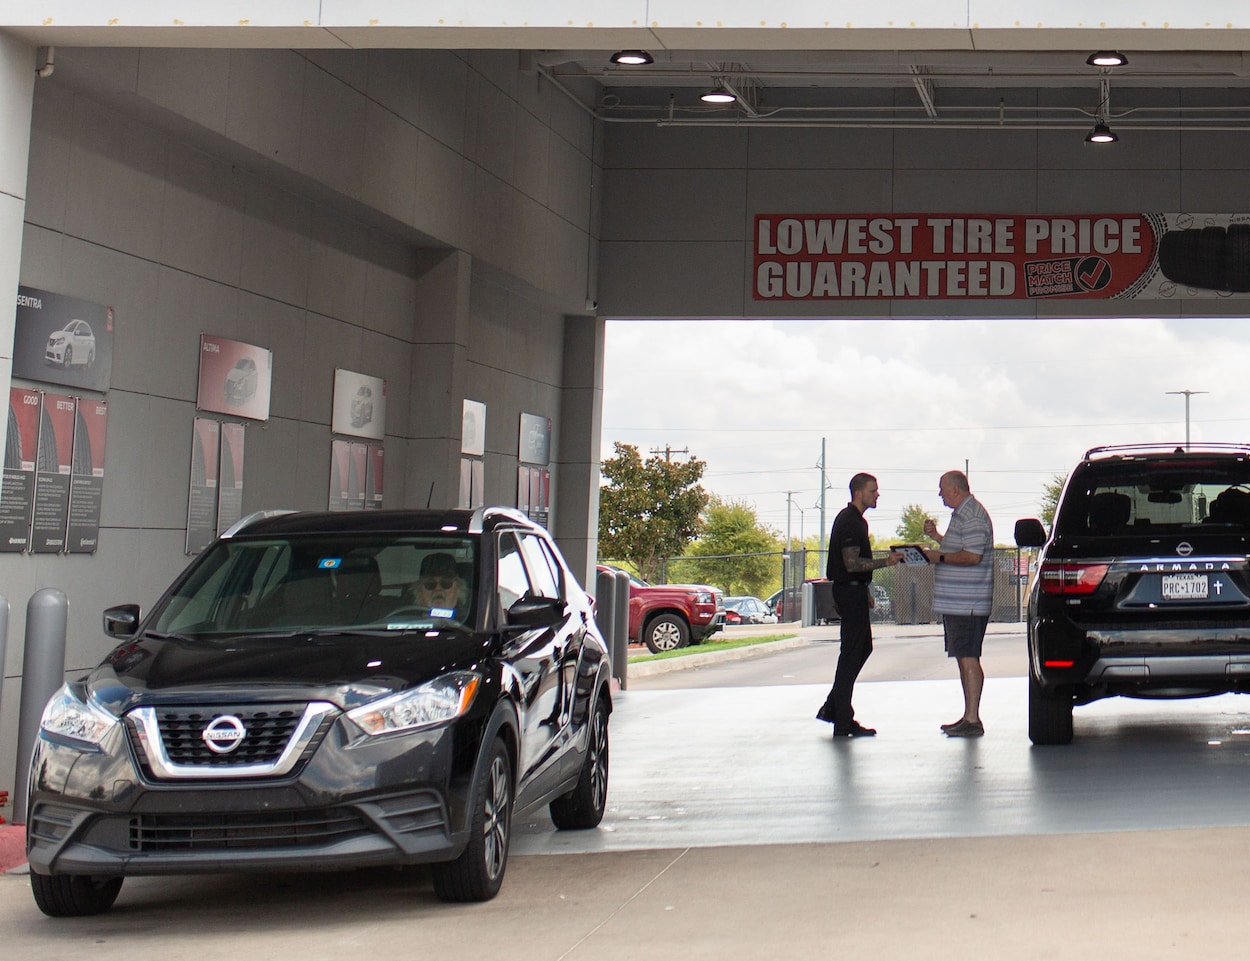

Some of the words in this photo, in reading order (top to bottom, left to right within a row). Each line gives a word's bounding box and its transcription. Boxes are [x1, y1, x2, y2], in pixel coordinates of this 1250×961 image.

[758, 218, 919, 255] LOWEST
[927, 218, 1015, 254] TIRE
[1025, 218, 1141, 254] PRICE
[1028, 261, 1071, 275] PRICE
[757, 260, 1016, 298] GUARANTEED
[1029, 272, 1072, 287] MATCH
[1029, 283, 1074, 296] PROMISE
[17, 294, 42, 310] SENTRA
[23, 394, 39, 406] GOOD
[56, 400, 74, 412] BETTER
[1140, 562, 1230, 571] ARMADA
